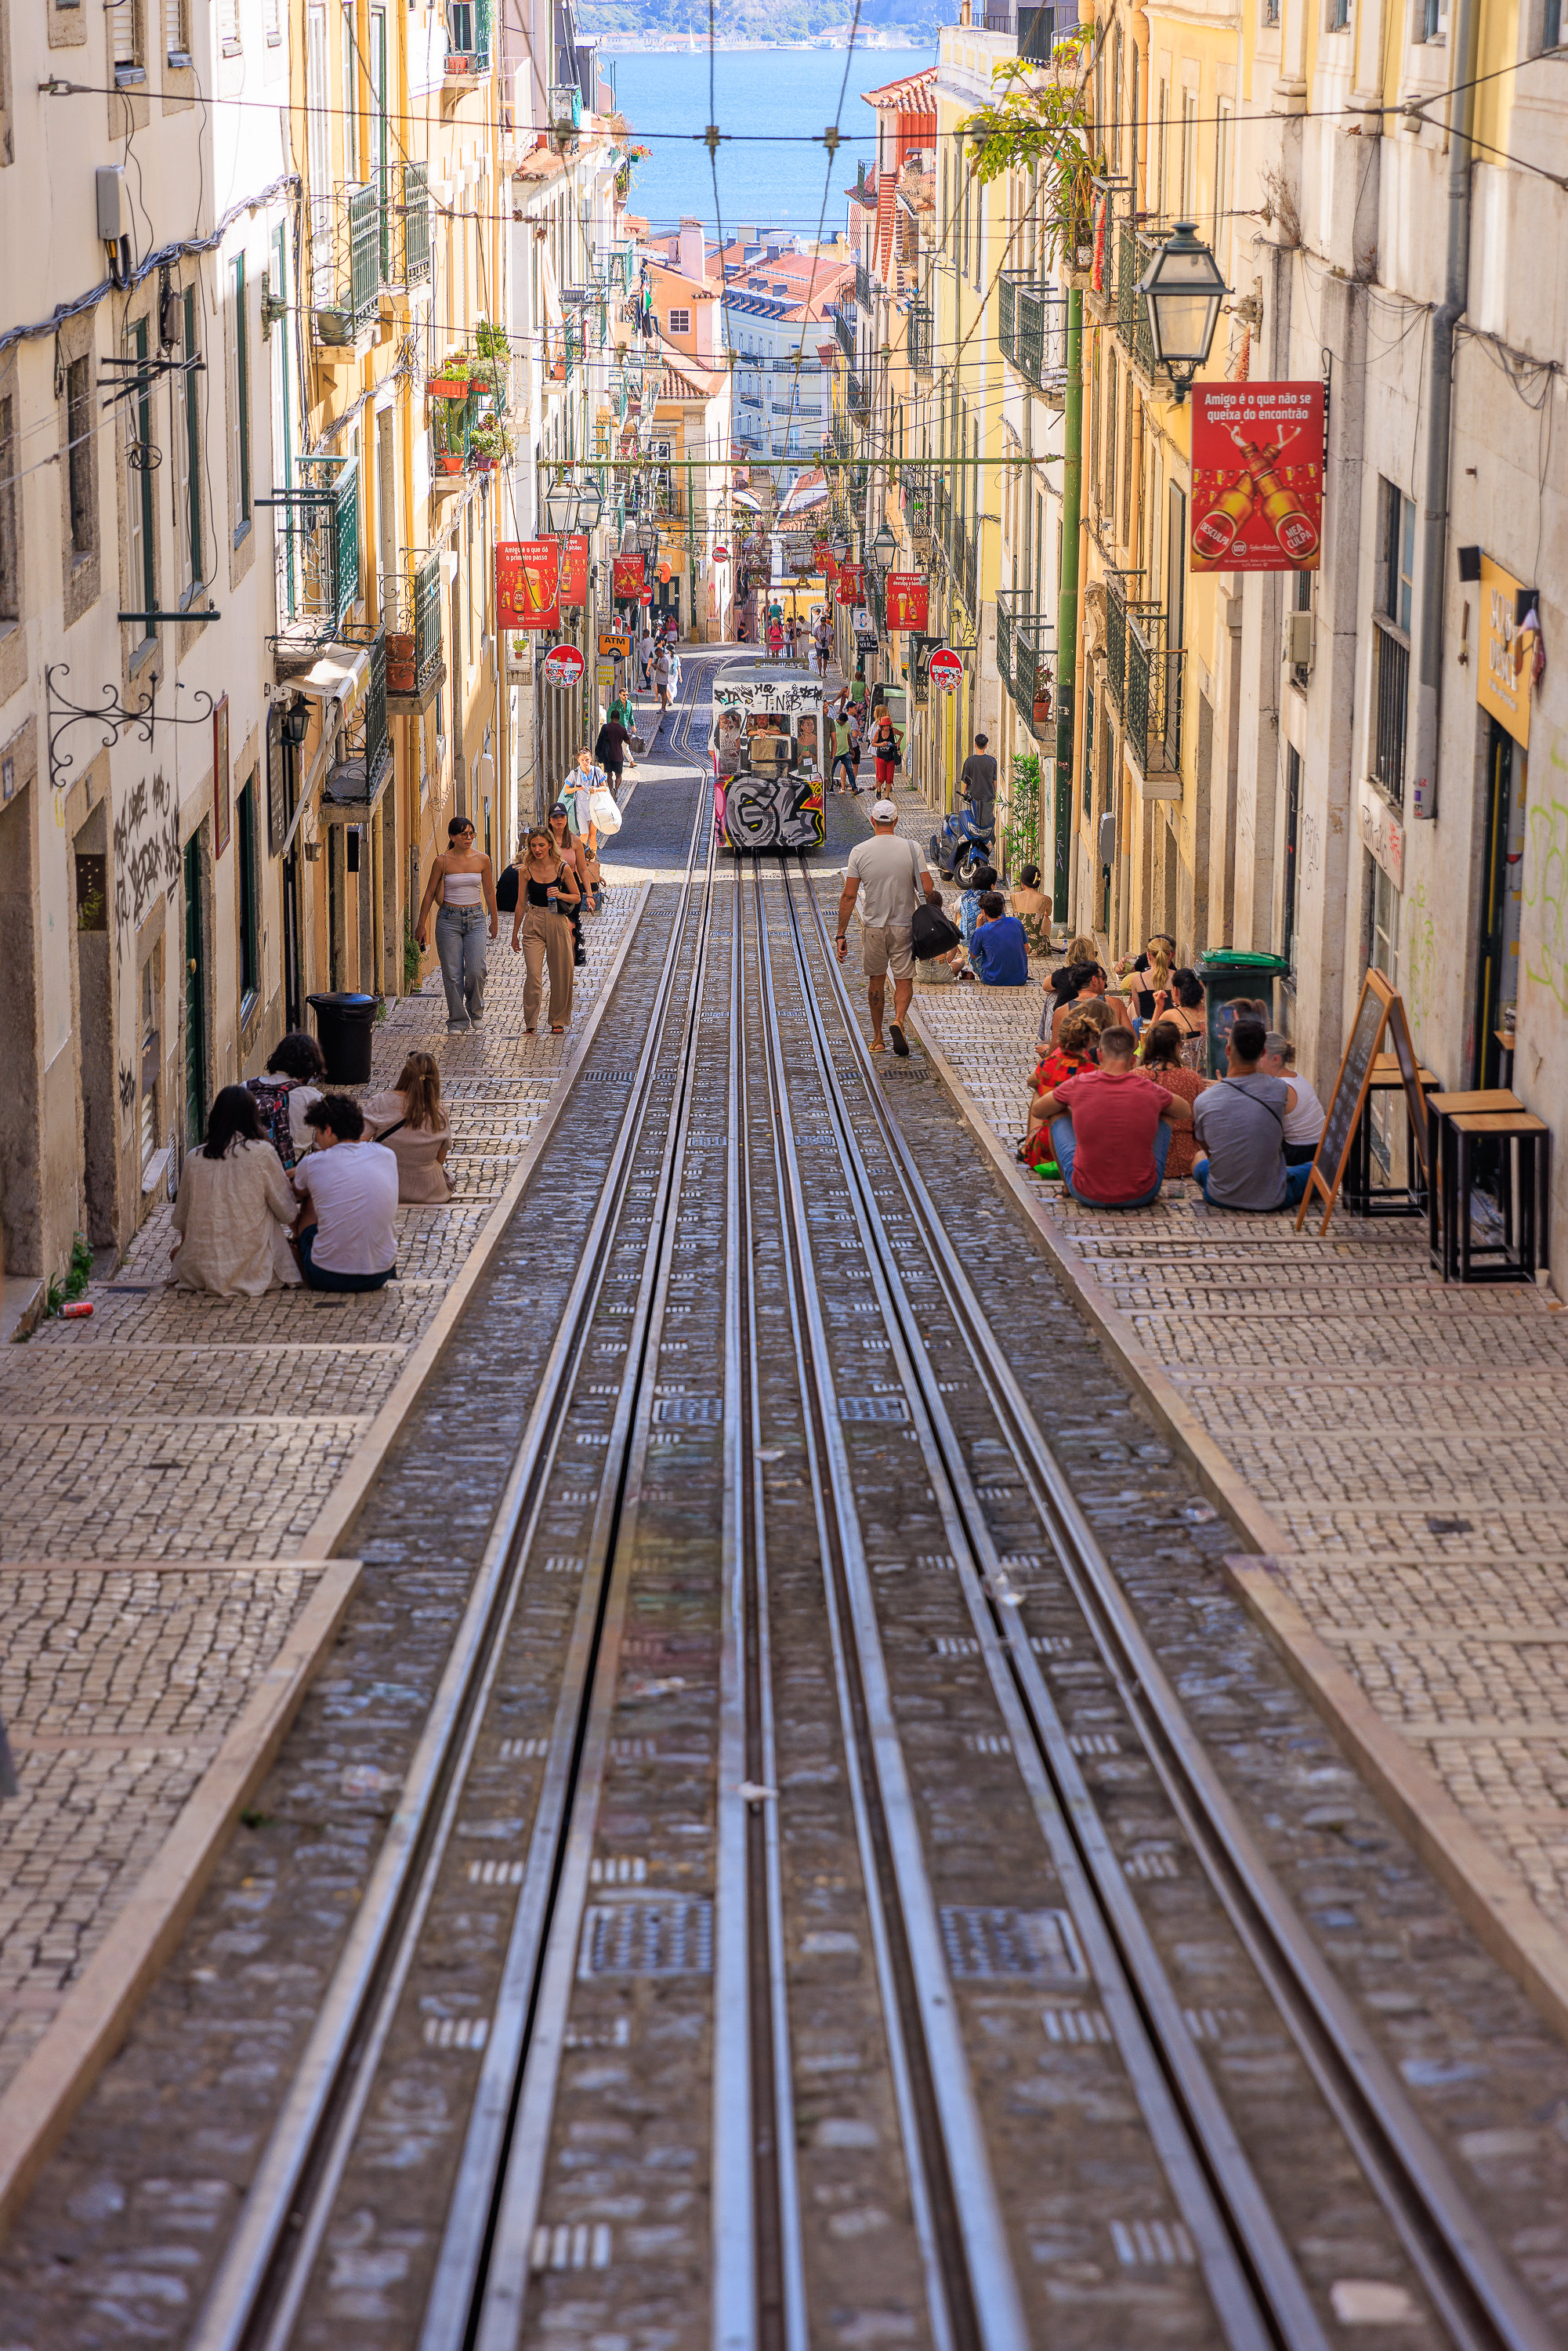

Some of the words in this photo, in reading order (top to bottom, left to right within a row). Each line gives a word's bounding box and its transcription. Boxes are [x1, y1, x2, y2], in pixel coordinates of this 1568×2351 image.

[1204, 393, 1237, 408] Amigo
[1239, 393, 1245, 404] é
[1248, 395, 1254, 404] o
[1257, 394, 1276, 408] que
[1278, 393, 1297, 404] não
[1299, 394, 1311, 404] se
[1207, 408, 1240, 423] queixa
[1243, 408, 1255, 420] do
[1258, 408, 1309, 420] encontrão
[1199, 522, 1230, 546] DESCULPA
[1284, 523, 1304, 538] MEA
[1287, 530, 1313, 549] CULPA
[604, 636, 625, 645] ATM
